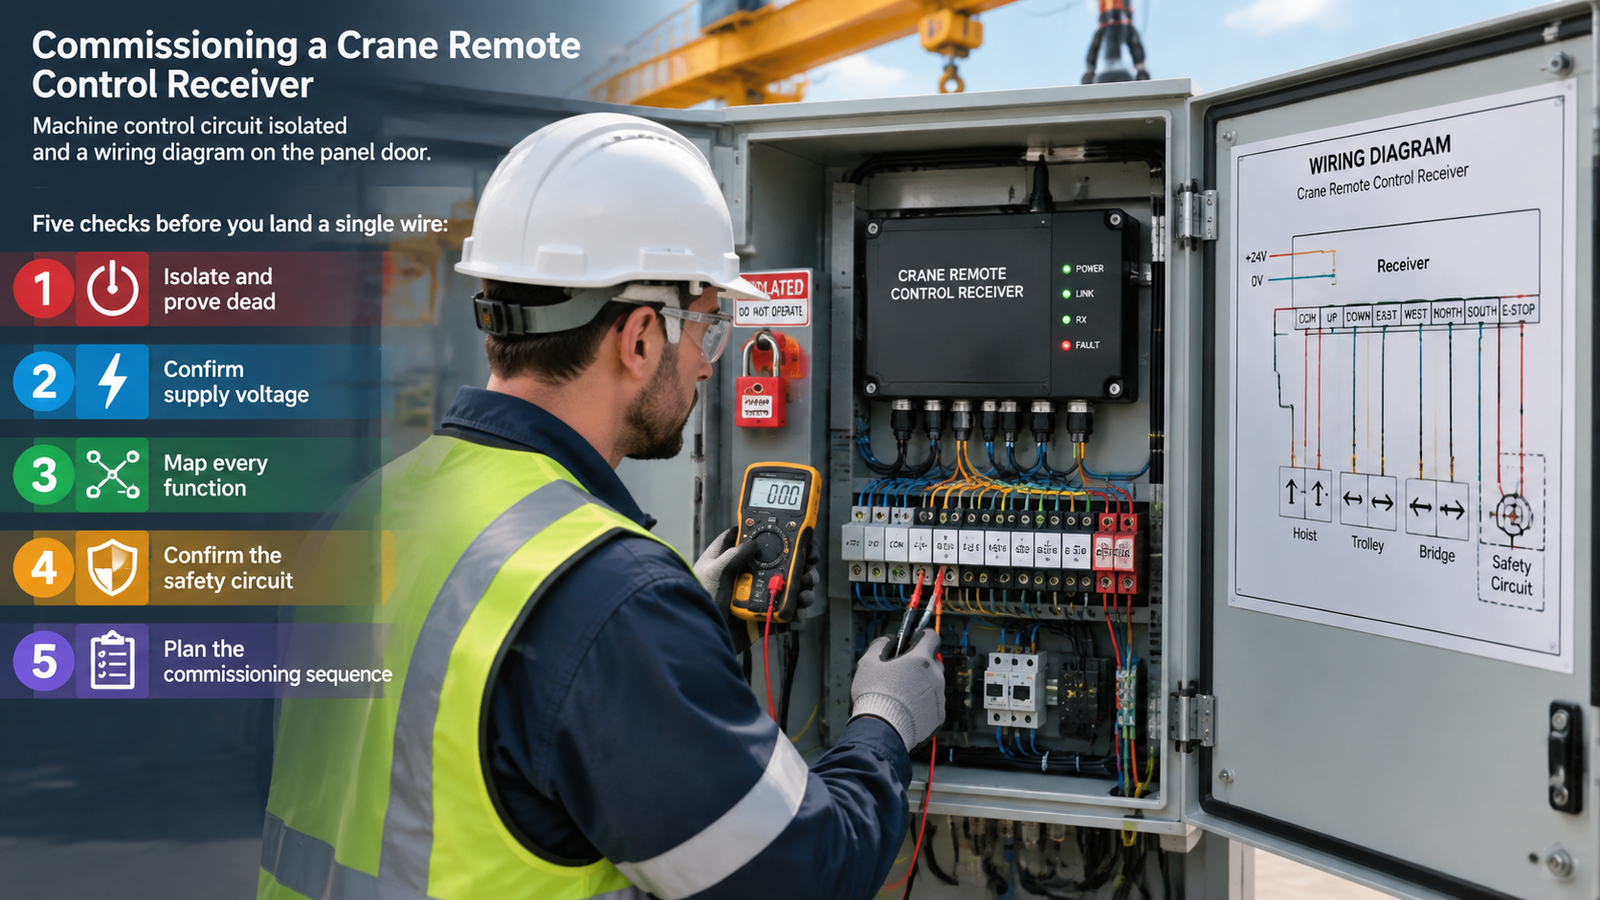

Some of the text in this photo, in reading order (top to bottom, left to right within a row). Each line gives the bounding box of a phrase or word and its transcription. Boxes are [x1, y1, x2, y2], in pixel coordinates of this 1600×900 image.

[1310, 134, 1451, 174] WIRING DIAGRAM
[1298, 165, 1469, 200] Crane Remote Control Receiver
[1246, 251, 1267, 263] +24V
[1076, 265, 1103, 273] POWER
[1378, 257, 1429, 272] Receiver
[899, 267, 1006, 281] CRANE REMOTE
[1252, 275, 1263, 287] 0V
[891, 285, 1023, 300] CONTROL RECEIVER
[1076, 290, 1094, 298] LINK
[739, 305, 750, 317] DO
[1346, 310, 1371, 323] DOWN
[1404, 308, 1428, 321] WEST
[1467, 305, 1497, 318] SOUTH
[1502, 303, 1536, 317] E-STOP
[1076, 316, 1087, 324] RX
[1326, 312, 1338, 323] UP
[1076, 341, 1100, 349] FAULT
[1294, 527, 1317, 541] Hoist
[1352, 535, 1384, 554] Trolley
[1420, 545, 1455, 564] Bridge
[1493, 555, 1532, 573] Safety
[1492, 576, 1533, 596] Circuit
